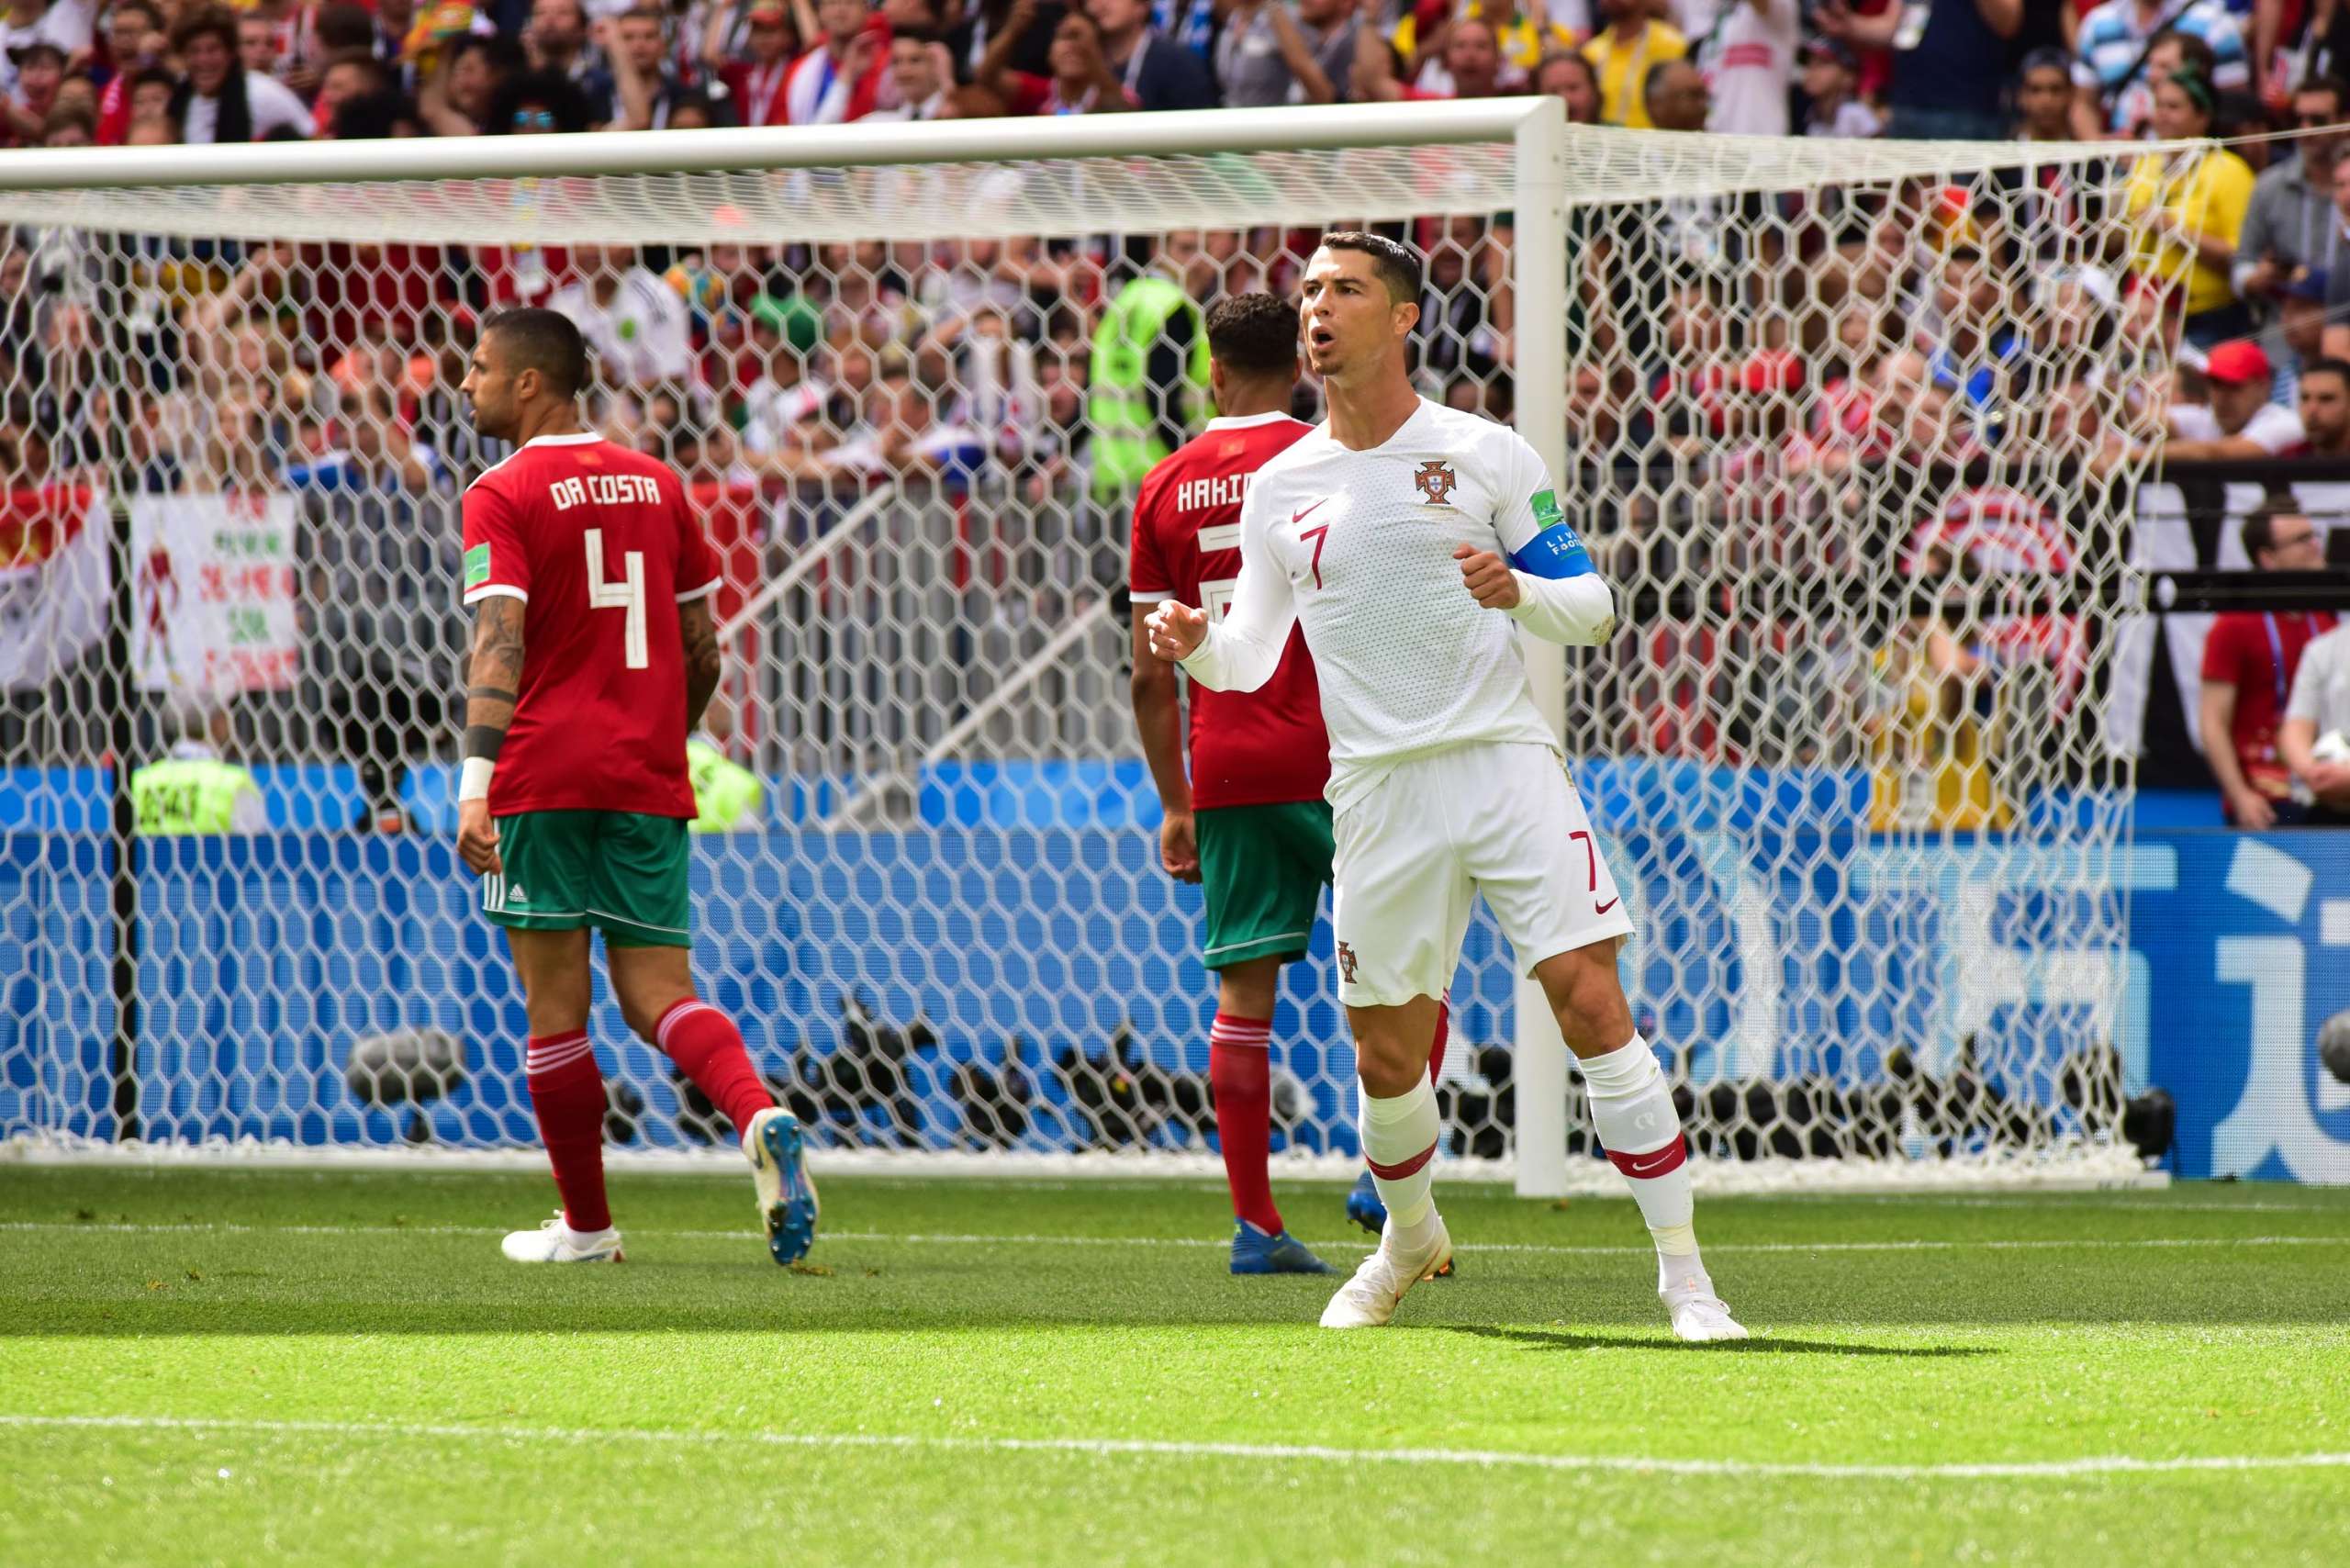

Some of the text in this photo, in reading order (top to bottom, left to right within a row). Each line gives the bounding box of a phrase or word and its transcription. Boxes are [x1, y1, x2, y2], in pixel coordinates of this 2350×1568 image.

[550, 475, 661, 510] DA COSTA
[1300, 524, 1329, 590] 7
[584, 528, 648, 669] 4
[1569, 831, 1595, 891] 7
